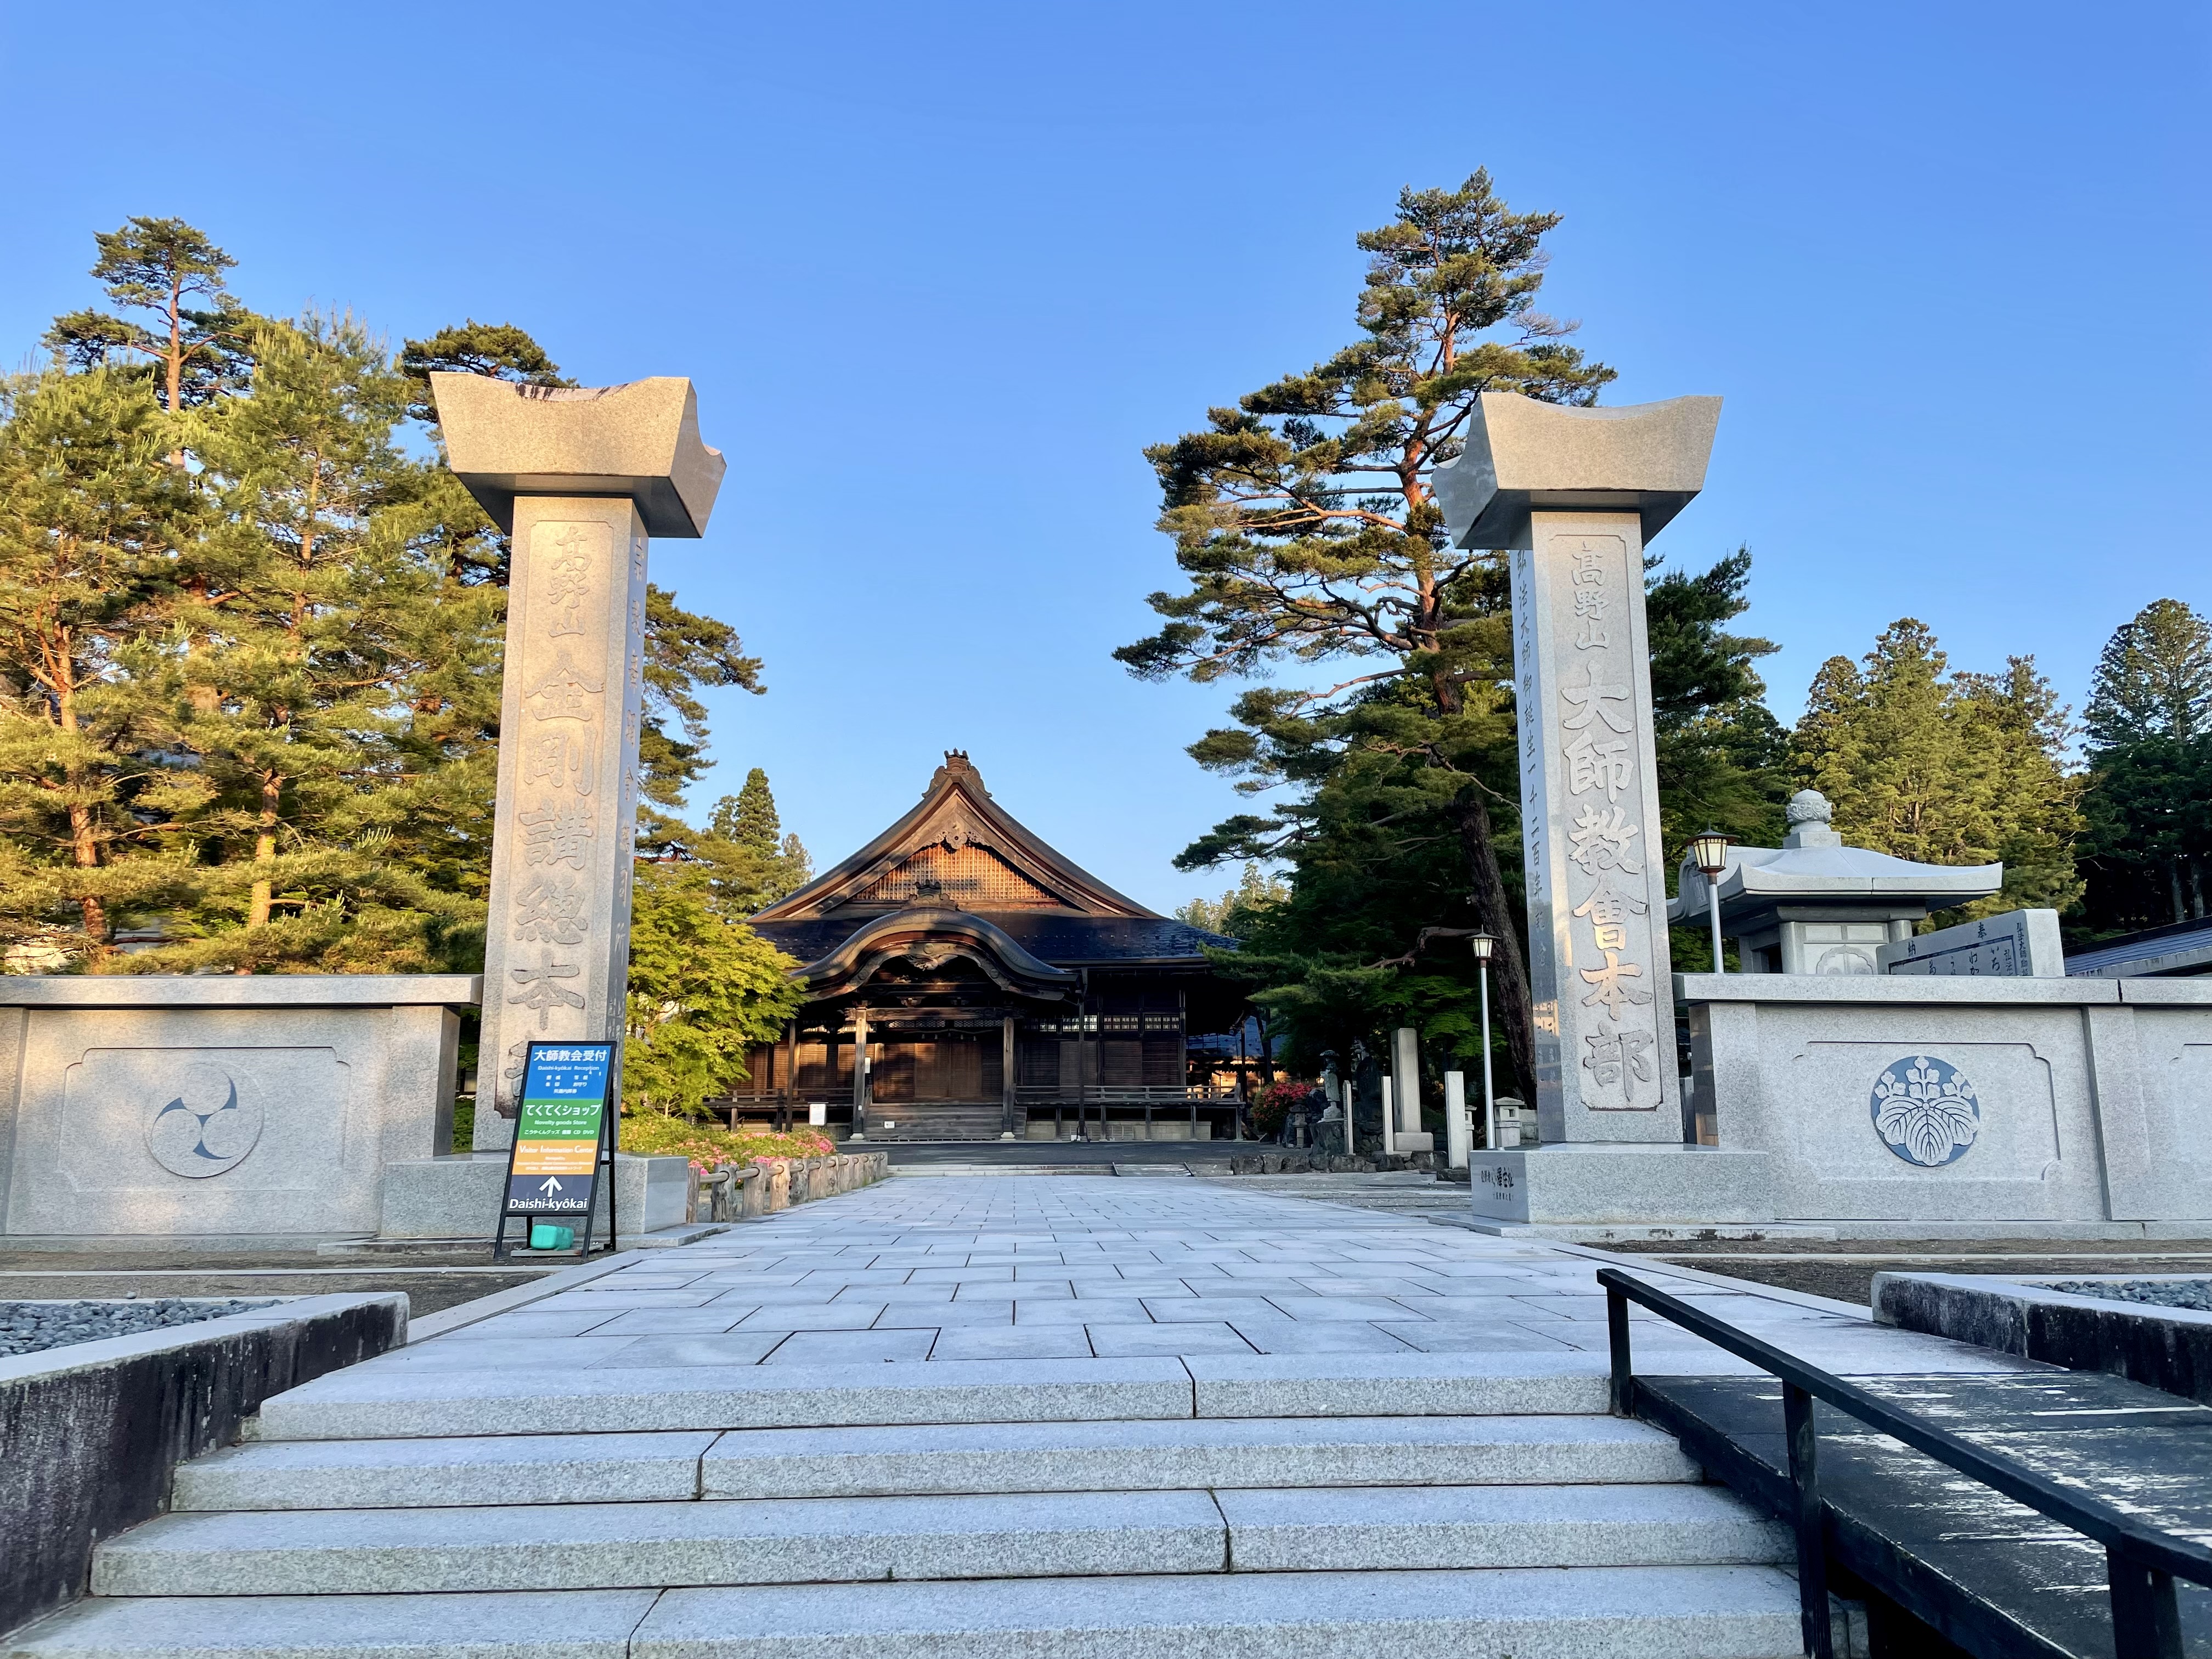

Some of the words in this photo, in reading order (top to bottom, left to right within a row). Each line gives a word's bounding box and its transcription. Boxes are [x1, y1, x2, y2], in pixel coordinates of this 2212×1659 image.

[533, 1049, 607, 1062] 大師教会受付
[526, 1104, 602, 1116] てくてくショップ
[520, 1145, 539, 1153] Visitor
[540, 1145, 573, 1153] Information
[574, 1145, 595, 1153] Center
[509, 1198, 588, 1211] Daishi-kyôkai
